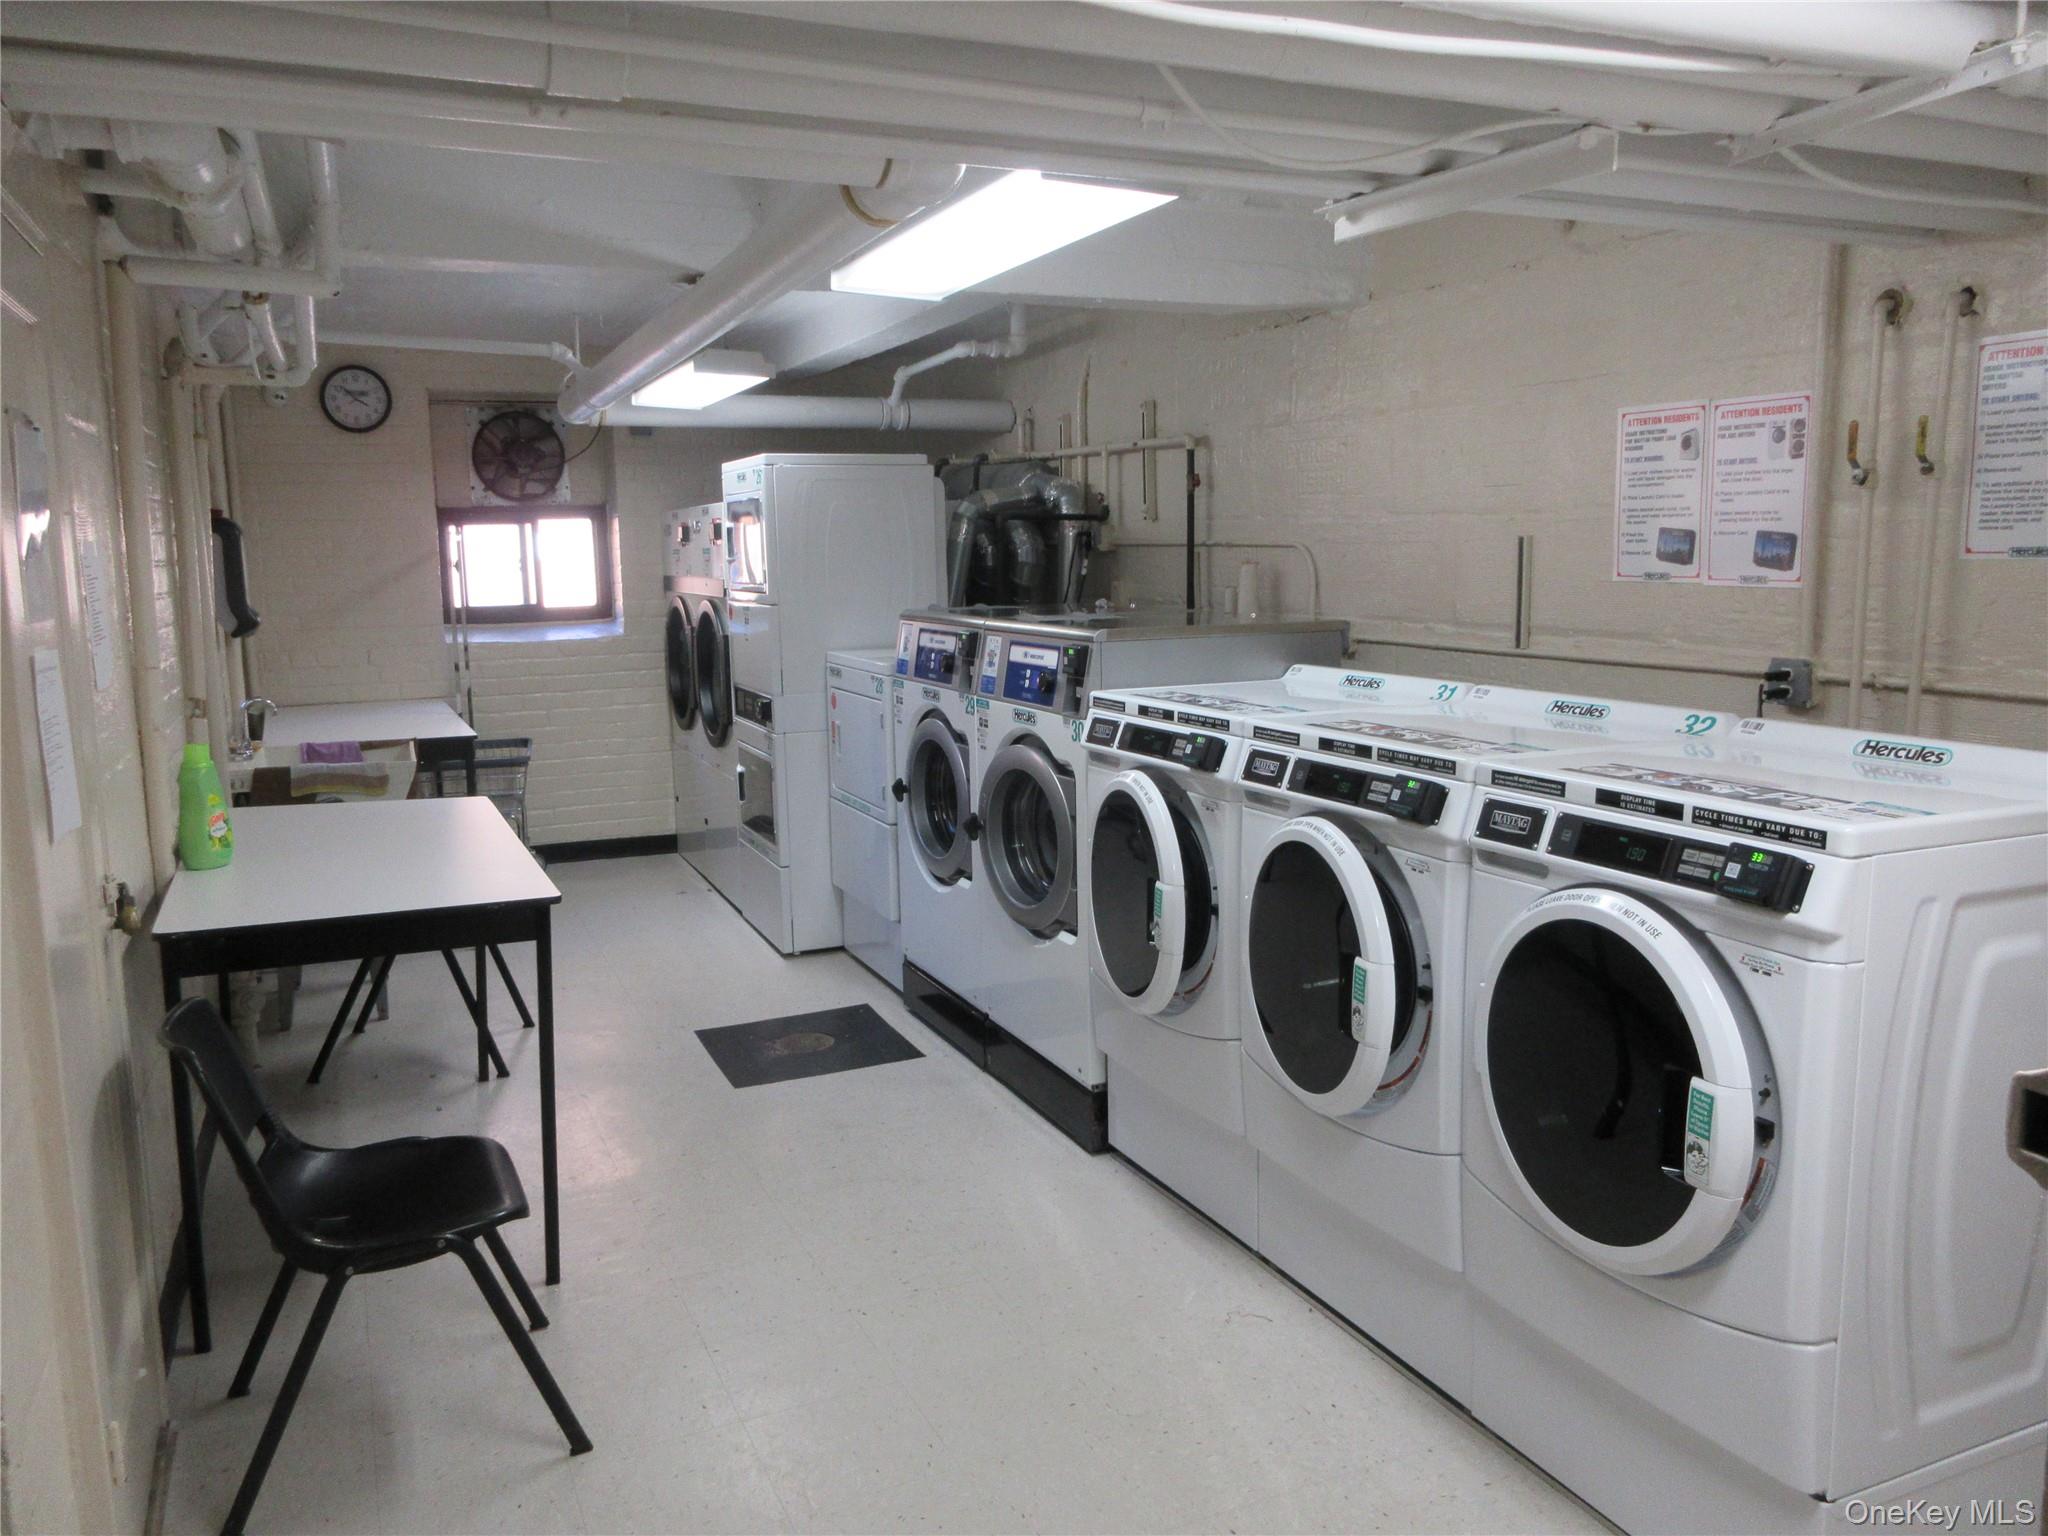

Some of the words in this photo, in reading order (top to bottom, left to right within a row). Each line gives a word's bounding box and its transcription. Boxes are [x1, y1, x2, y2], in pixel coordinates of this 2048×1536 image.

[1988, 345, 2044, 361] ATTENTION
[1627, 415, 1662, 427] ATTENTION
[1664, 412, 1700, 424] RESIDENTS
[1720, 408, 1760, 420] ATTENTION
[1761, 403, 1803, 416] RESIDENTS
[1343, 675, 1382, 689] Hercules
[1429, 684, 1458, 701] 31
[965, 696, 975, 715] 29
[1550, 701, 1605, 718] Hercules
[1014, 709, 1036, 724] Hercules
[1674, 713, 1717, 736] 32
[1071, 720, 1084, 742] 30
[1861, 740, 1945, 764] Hercules
[1494, 812, 1528, 828] MAYTAG
[1694, 809, 1718, 820] CYCLE
[1720, 814, 1744, 825] TIMES
[1747, 819, 1763, 829] MAY
[1765, 823, 1787, 834] VARY
[1789, 827, 1806, 837] DUE
[1564, 893, 1583, 901] DOOR
[1621, 907, 1640, 921] NOT
[1637, 917, 1648, 927] IN
[1645, 924, 1663, 940] USE
